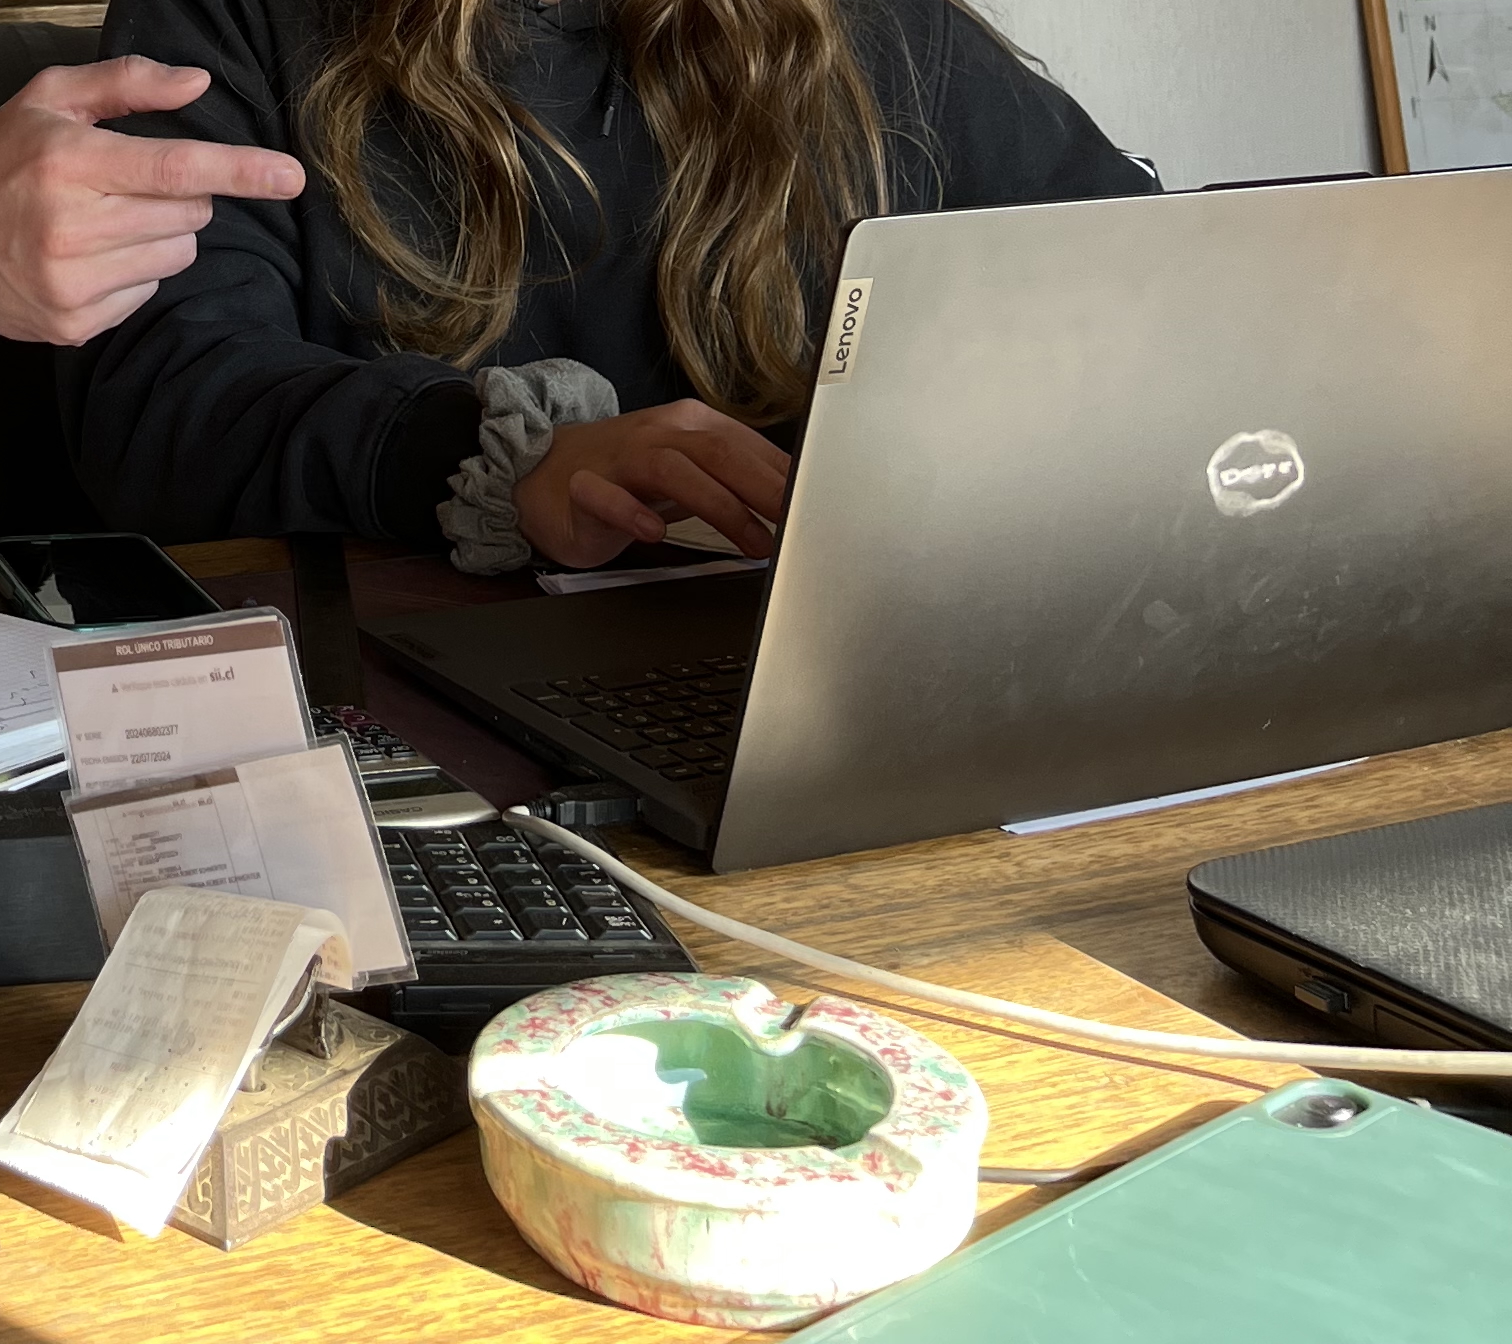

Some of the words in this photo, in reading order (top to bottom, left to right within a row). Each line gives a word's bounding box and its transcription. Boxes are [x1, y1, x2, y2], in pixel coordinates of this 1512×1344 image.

[1424, 15, 1436, 32] N
[828, 288, 862, 374] Lenovo
[115, 644, 134, 657] ROL
[134, 641, 161, 654] ÚNICO
[162, 634, 214, 650] TRIBUTARIO
[209, 666, 235, 683] sii.cl
